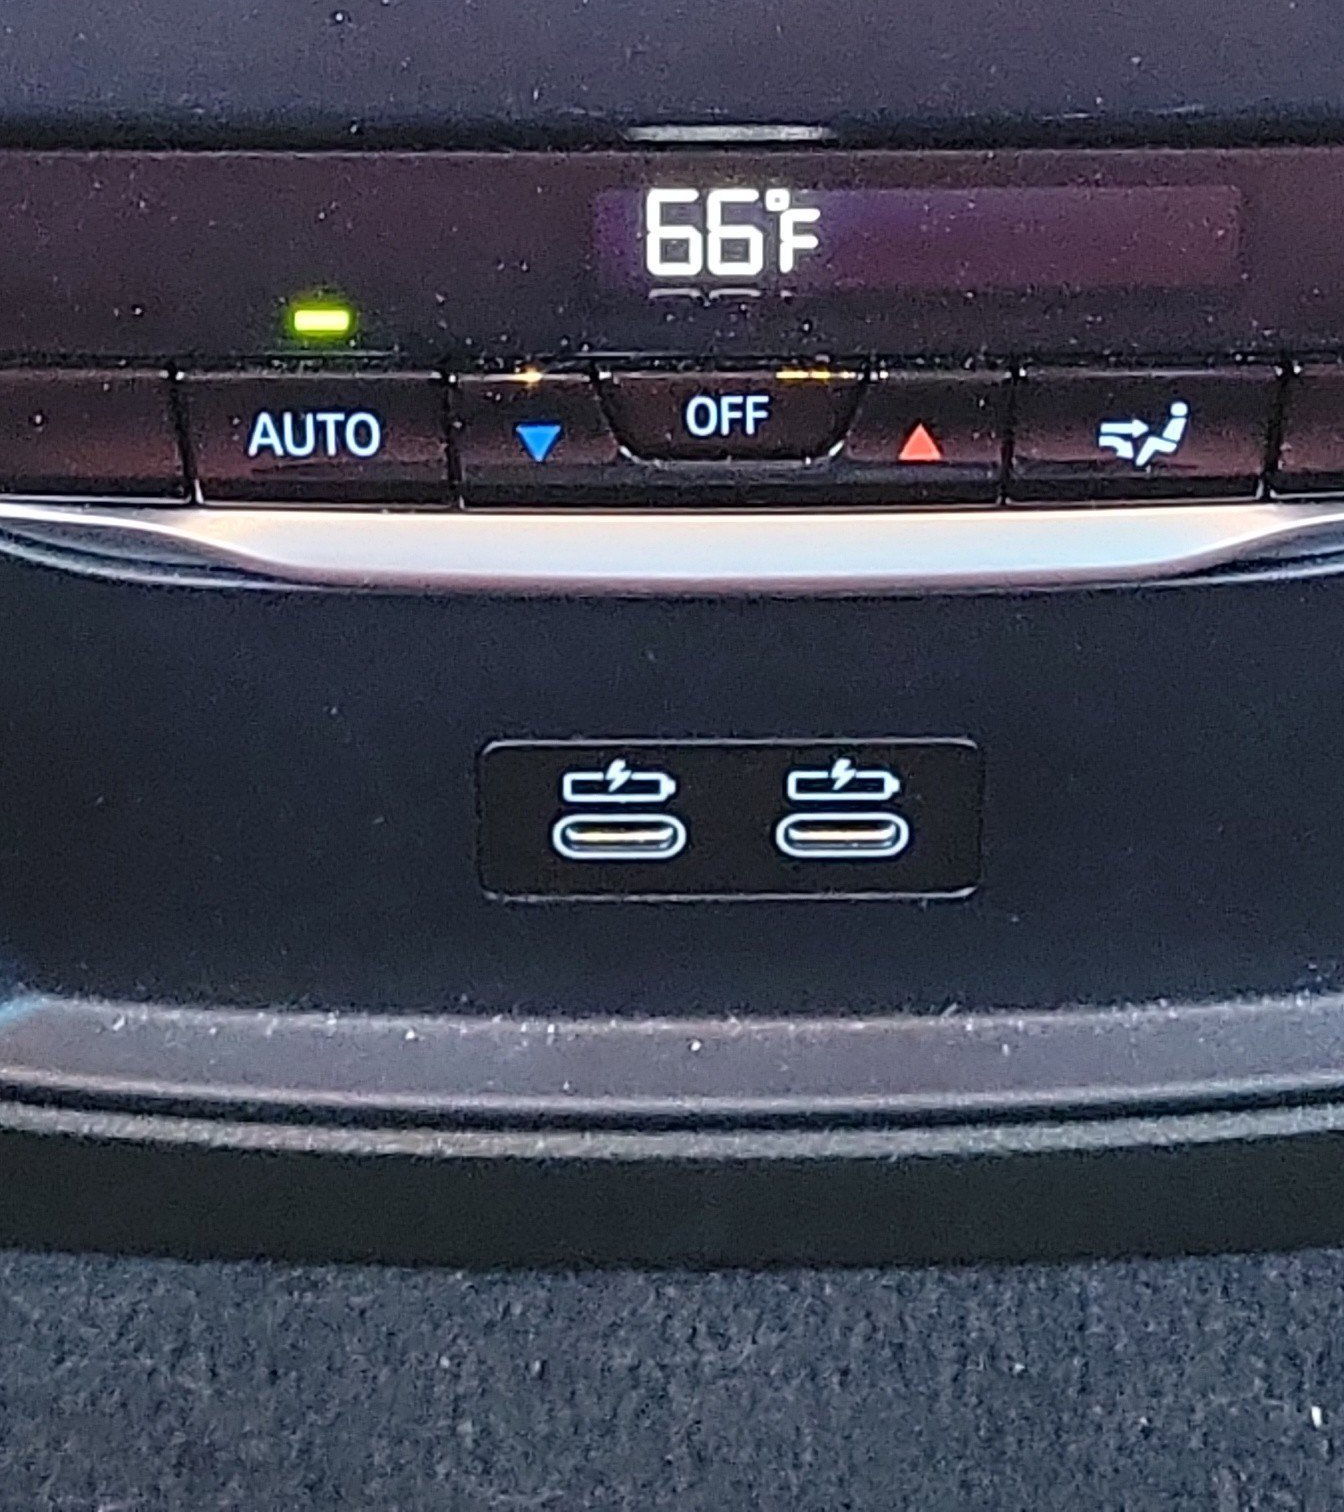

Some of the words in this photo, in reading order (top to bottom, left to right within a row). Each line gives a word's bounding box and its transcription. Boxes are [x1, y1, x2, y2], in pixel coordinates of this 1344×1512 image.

[646, 187, 821, 276] 66°F
[248, 411, 381, 457] AUTO
[685, 394, 770, 437] OFF
